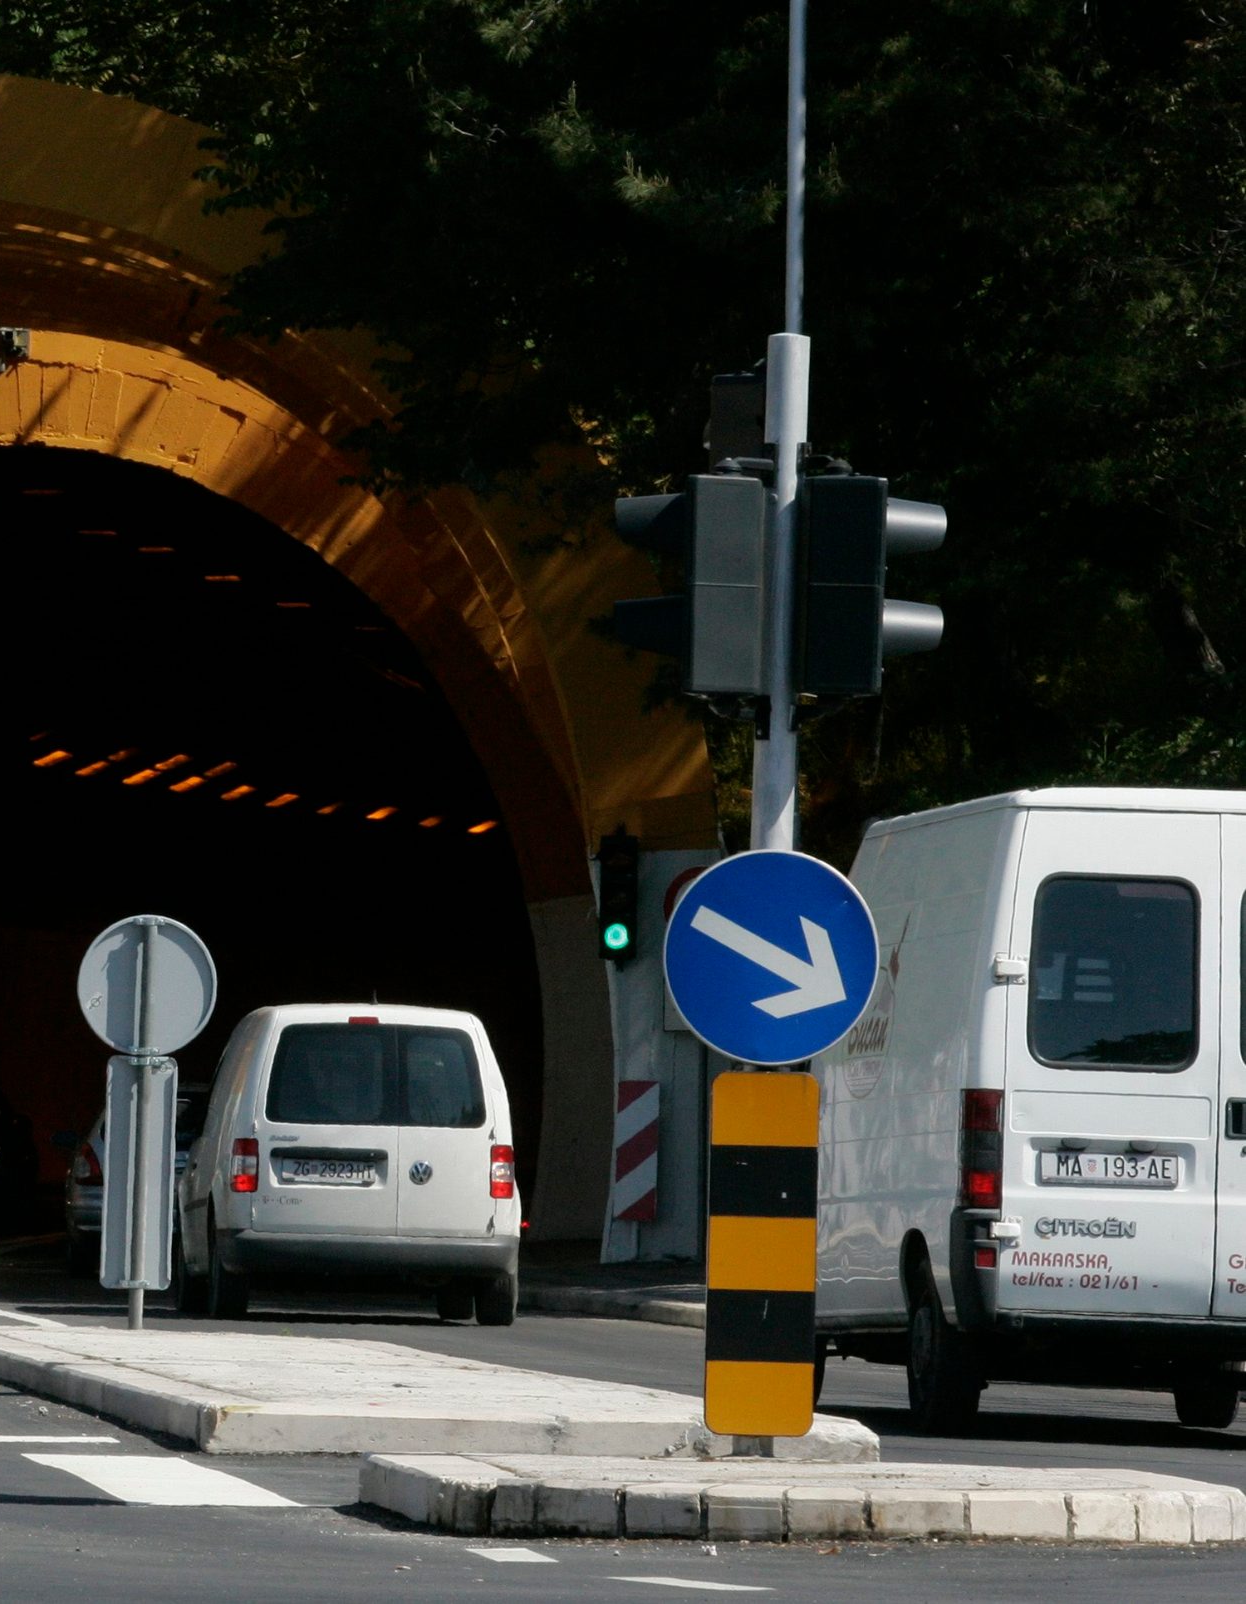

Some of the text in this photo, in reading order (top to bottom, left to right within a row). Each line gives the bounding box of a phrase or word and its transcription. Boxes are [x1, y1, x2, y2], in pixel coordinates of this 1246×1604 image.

[293, 1161, 310, 1176] ZG
[1056, 1155, 1172, 1180] MA 193-AE
[1034, 1216, 1137, 1238] CITROËN
[1011, 1250, 1114, 1273] MAKARSKA,
[1011, 1272, 1064, 1288] tel/fax
[1079, 1274, 1139, 1291] 021/61
